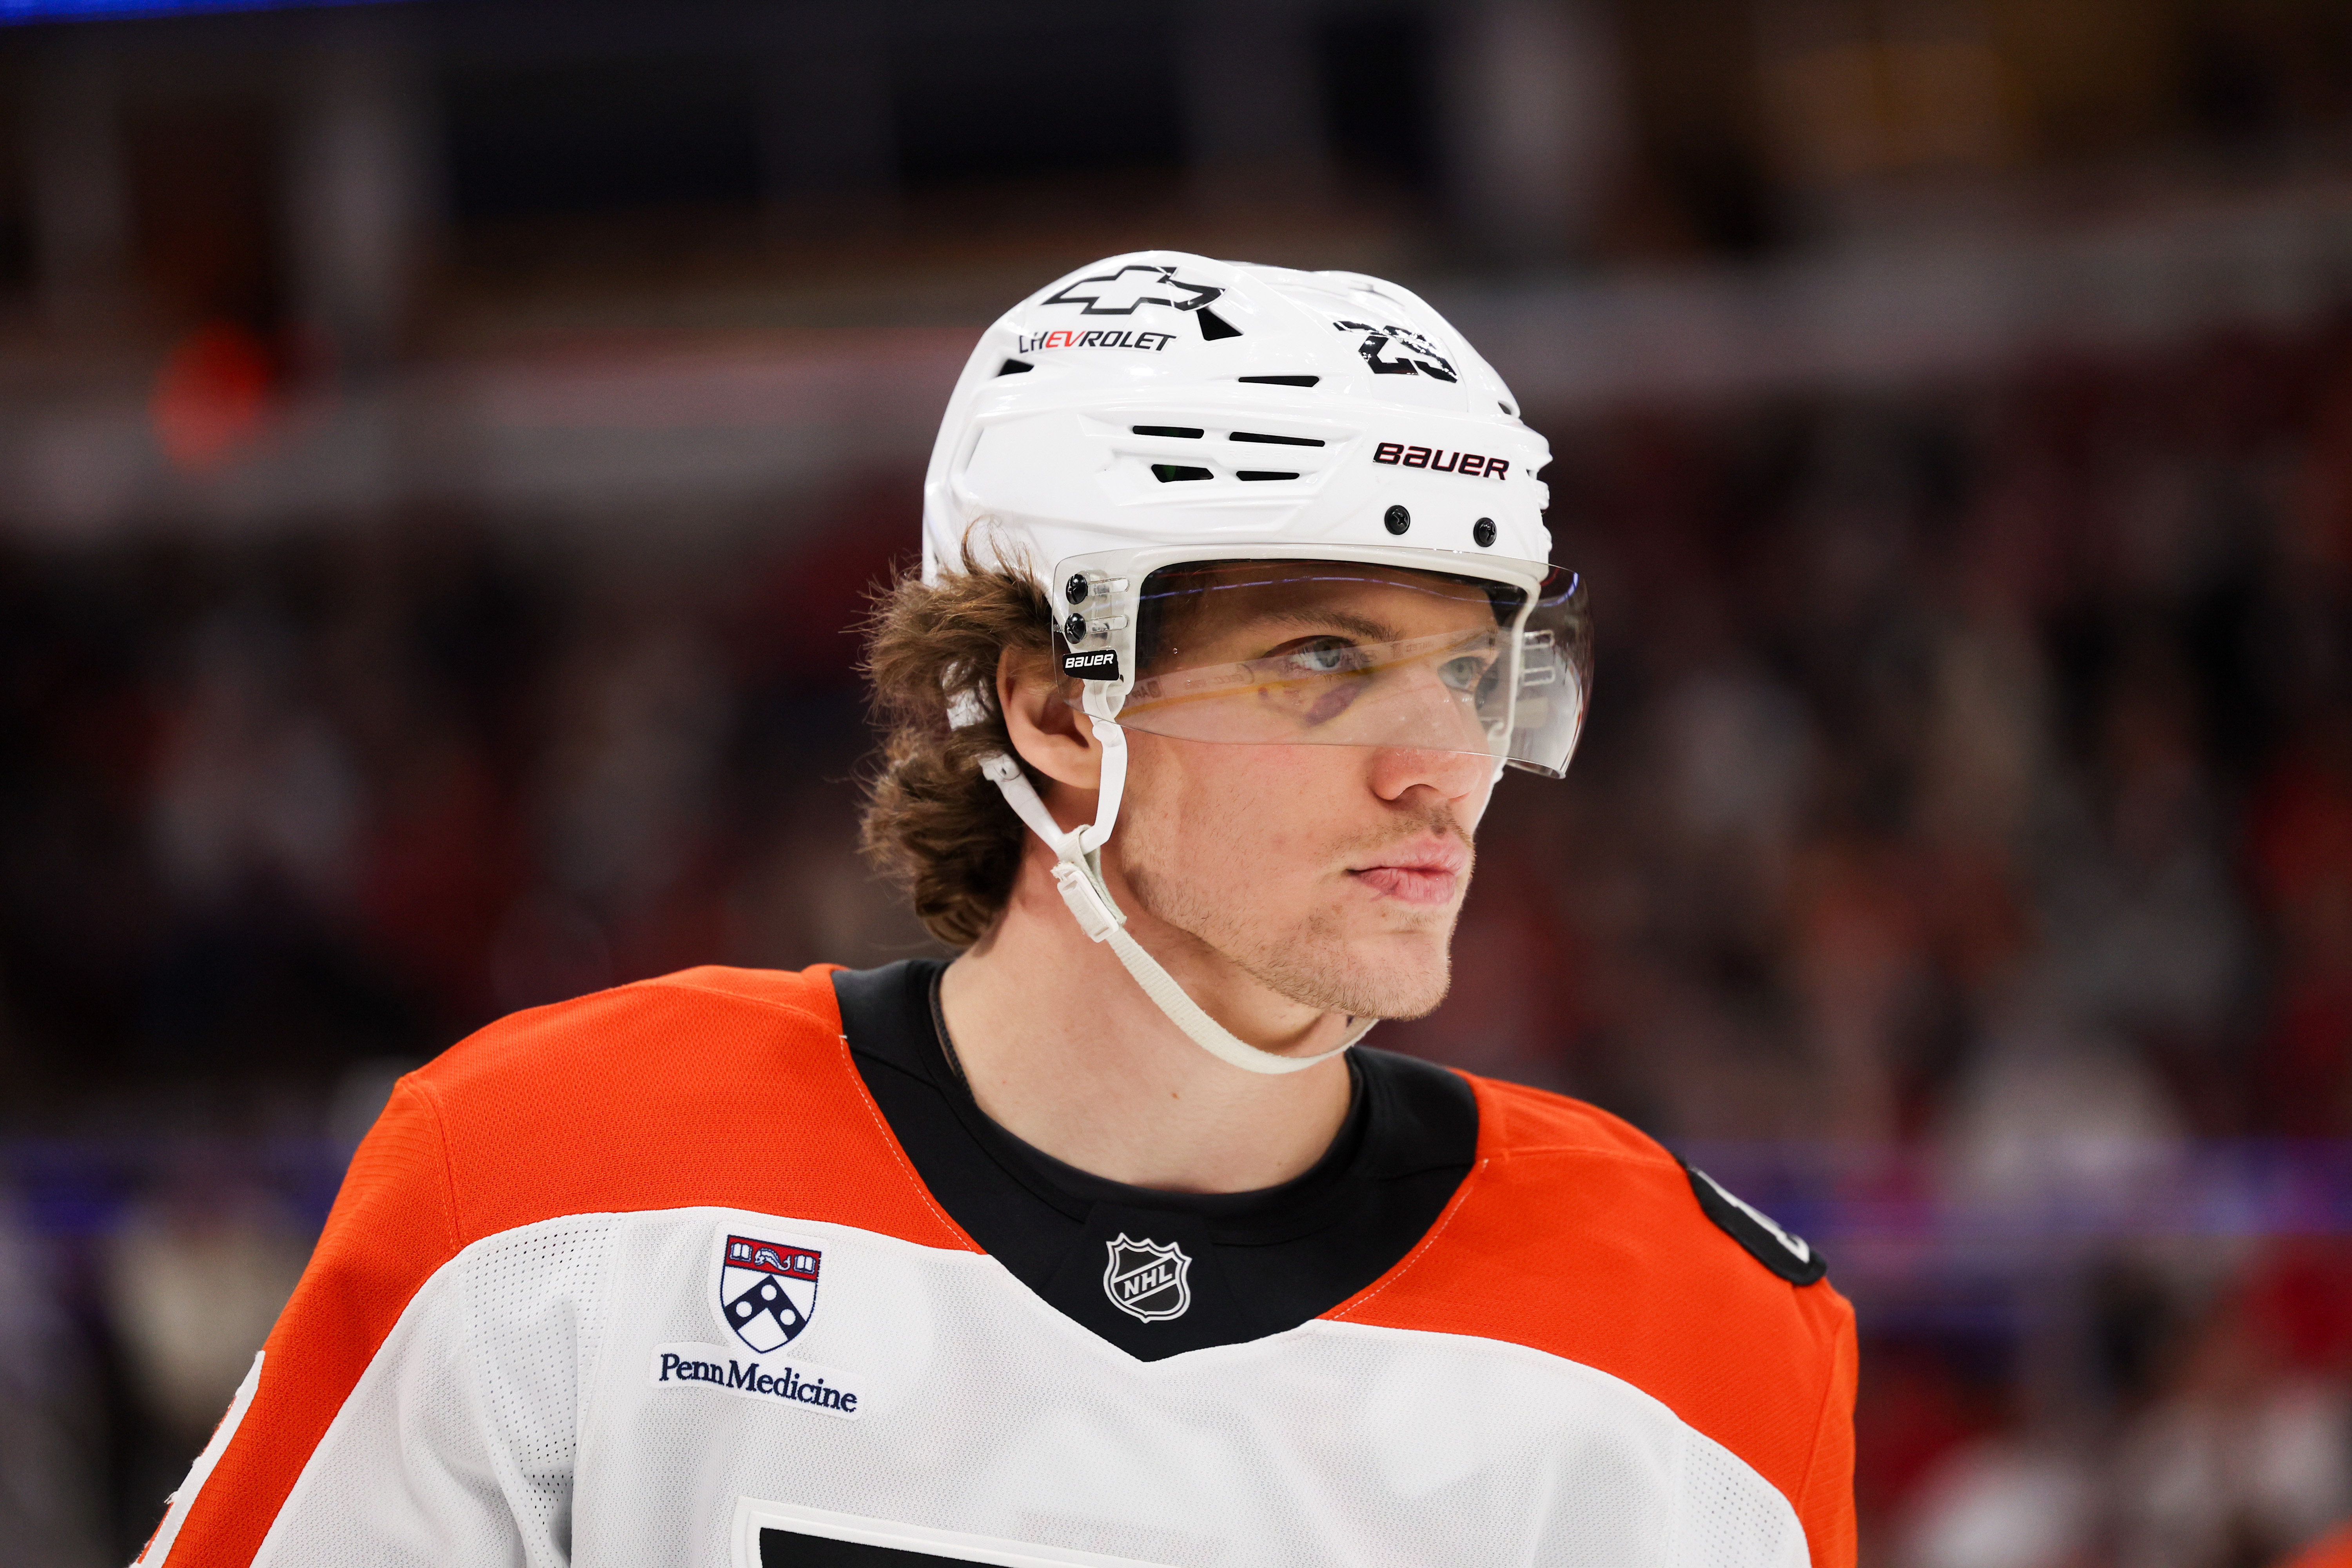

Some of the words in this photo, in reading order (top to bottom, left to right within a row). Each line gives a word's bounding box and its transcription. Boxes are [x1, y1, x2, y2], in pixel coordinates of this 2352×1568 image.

[1019, 330, 1177, 354] CHEVROLET
[1373, 442, 1510, 480] BAUER
[1065, 653, 1114, 668] BAUER
[1123, 1265, 1173, 1299] NHL
[659, 1353, 725, 1387] Penn
[726, 1360, 858, 1413] Medicine
